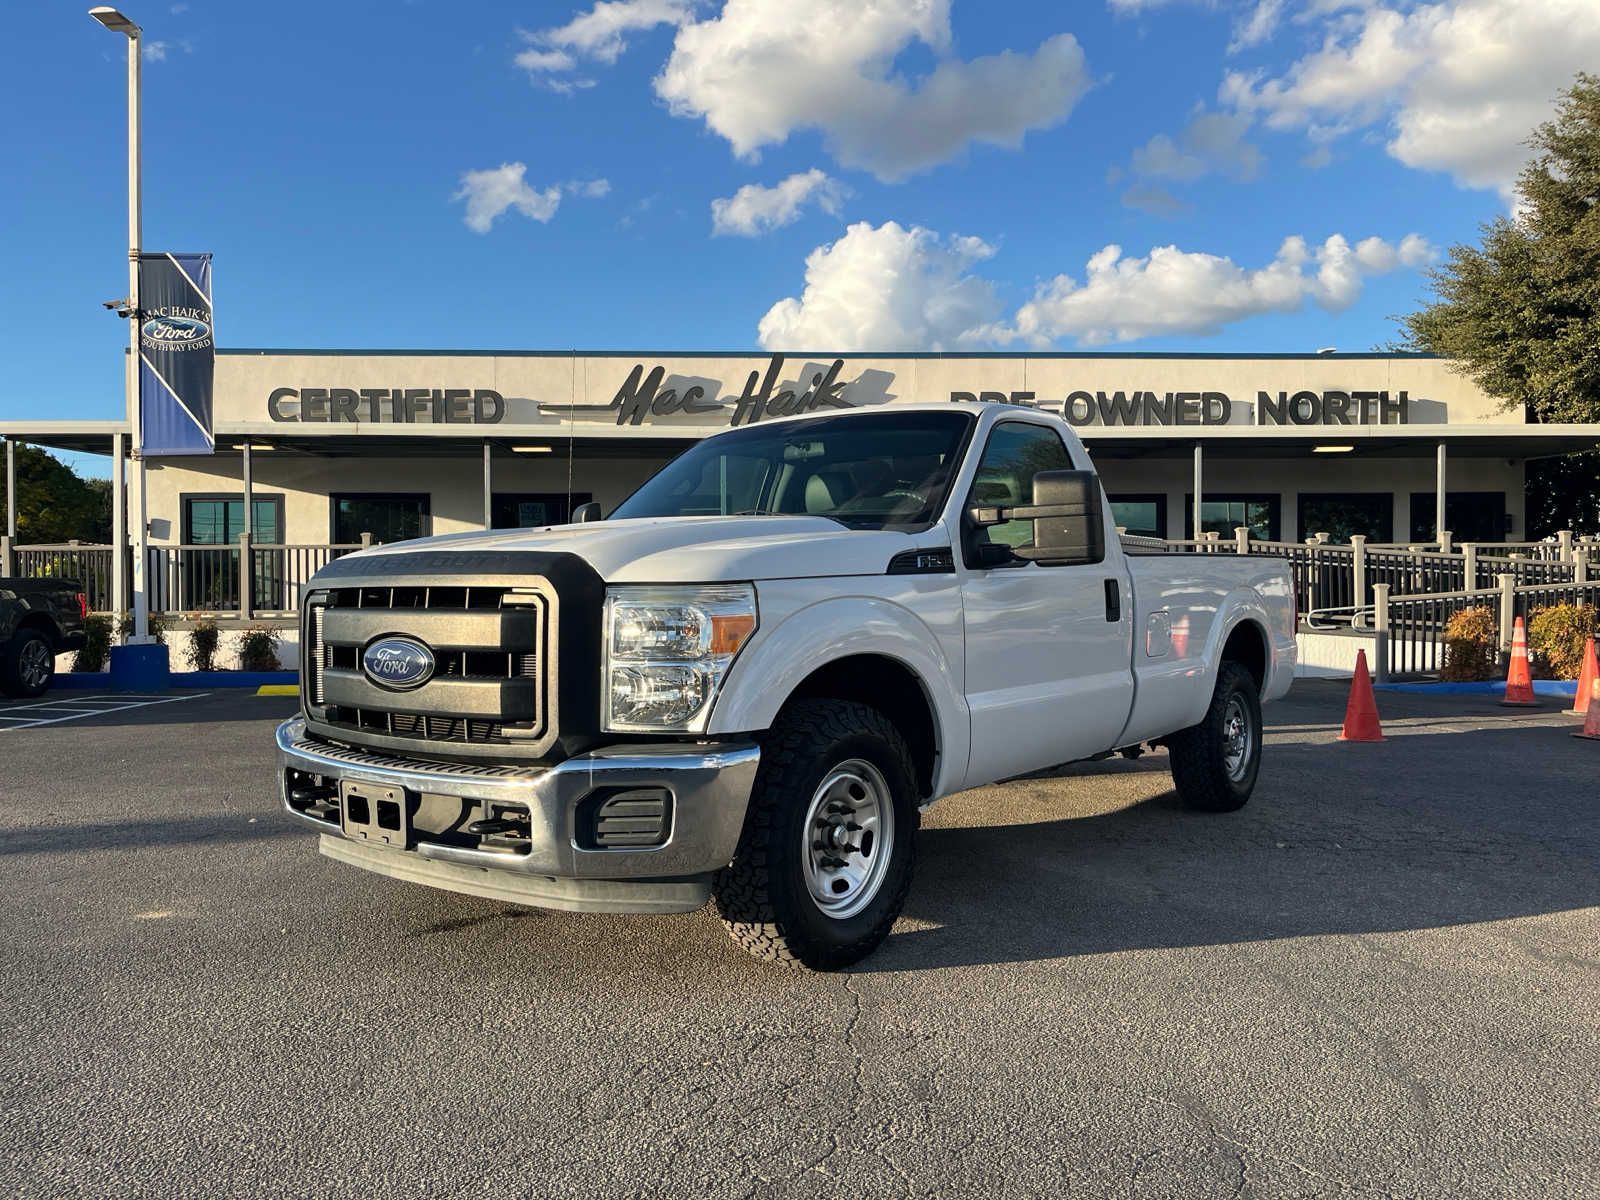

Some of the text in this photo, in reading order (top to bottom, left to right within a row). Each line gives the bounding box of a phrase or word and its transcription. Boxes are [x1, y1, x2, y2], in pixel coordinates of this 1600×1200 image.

[142, 306, 211, 322] MAC HAIK'S
[153, 323, 197, 339] Ford
[141, 339, 211, 352] SOUTHWAY FORD
[537, 352, 857, 427] Mac Haik
[268, 387, 505, 424] CERTIFIED
[950, 391, 1408, 426] -OWNED NORTH
[373, 647, 412, 674] Ford
